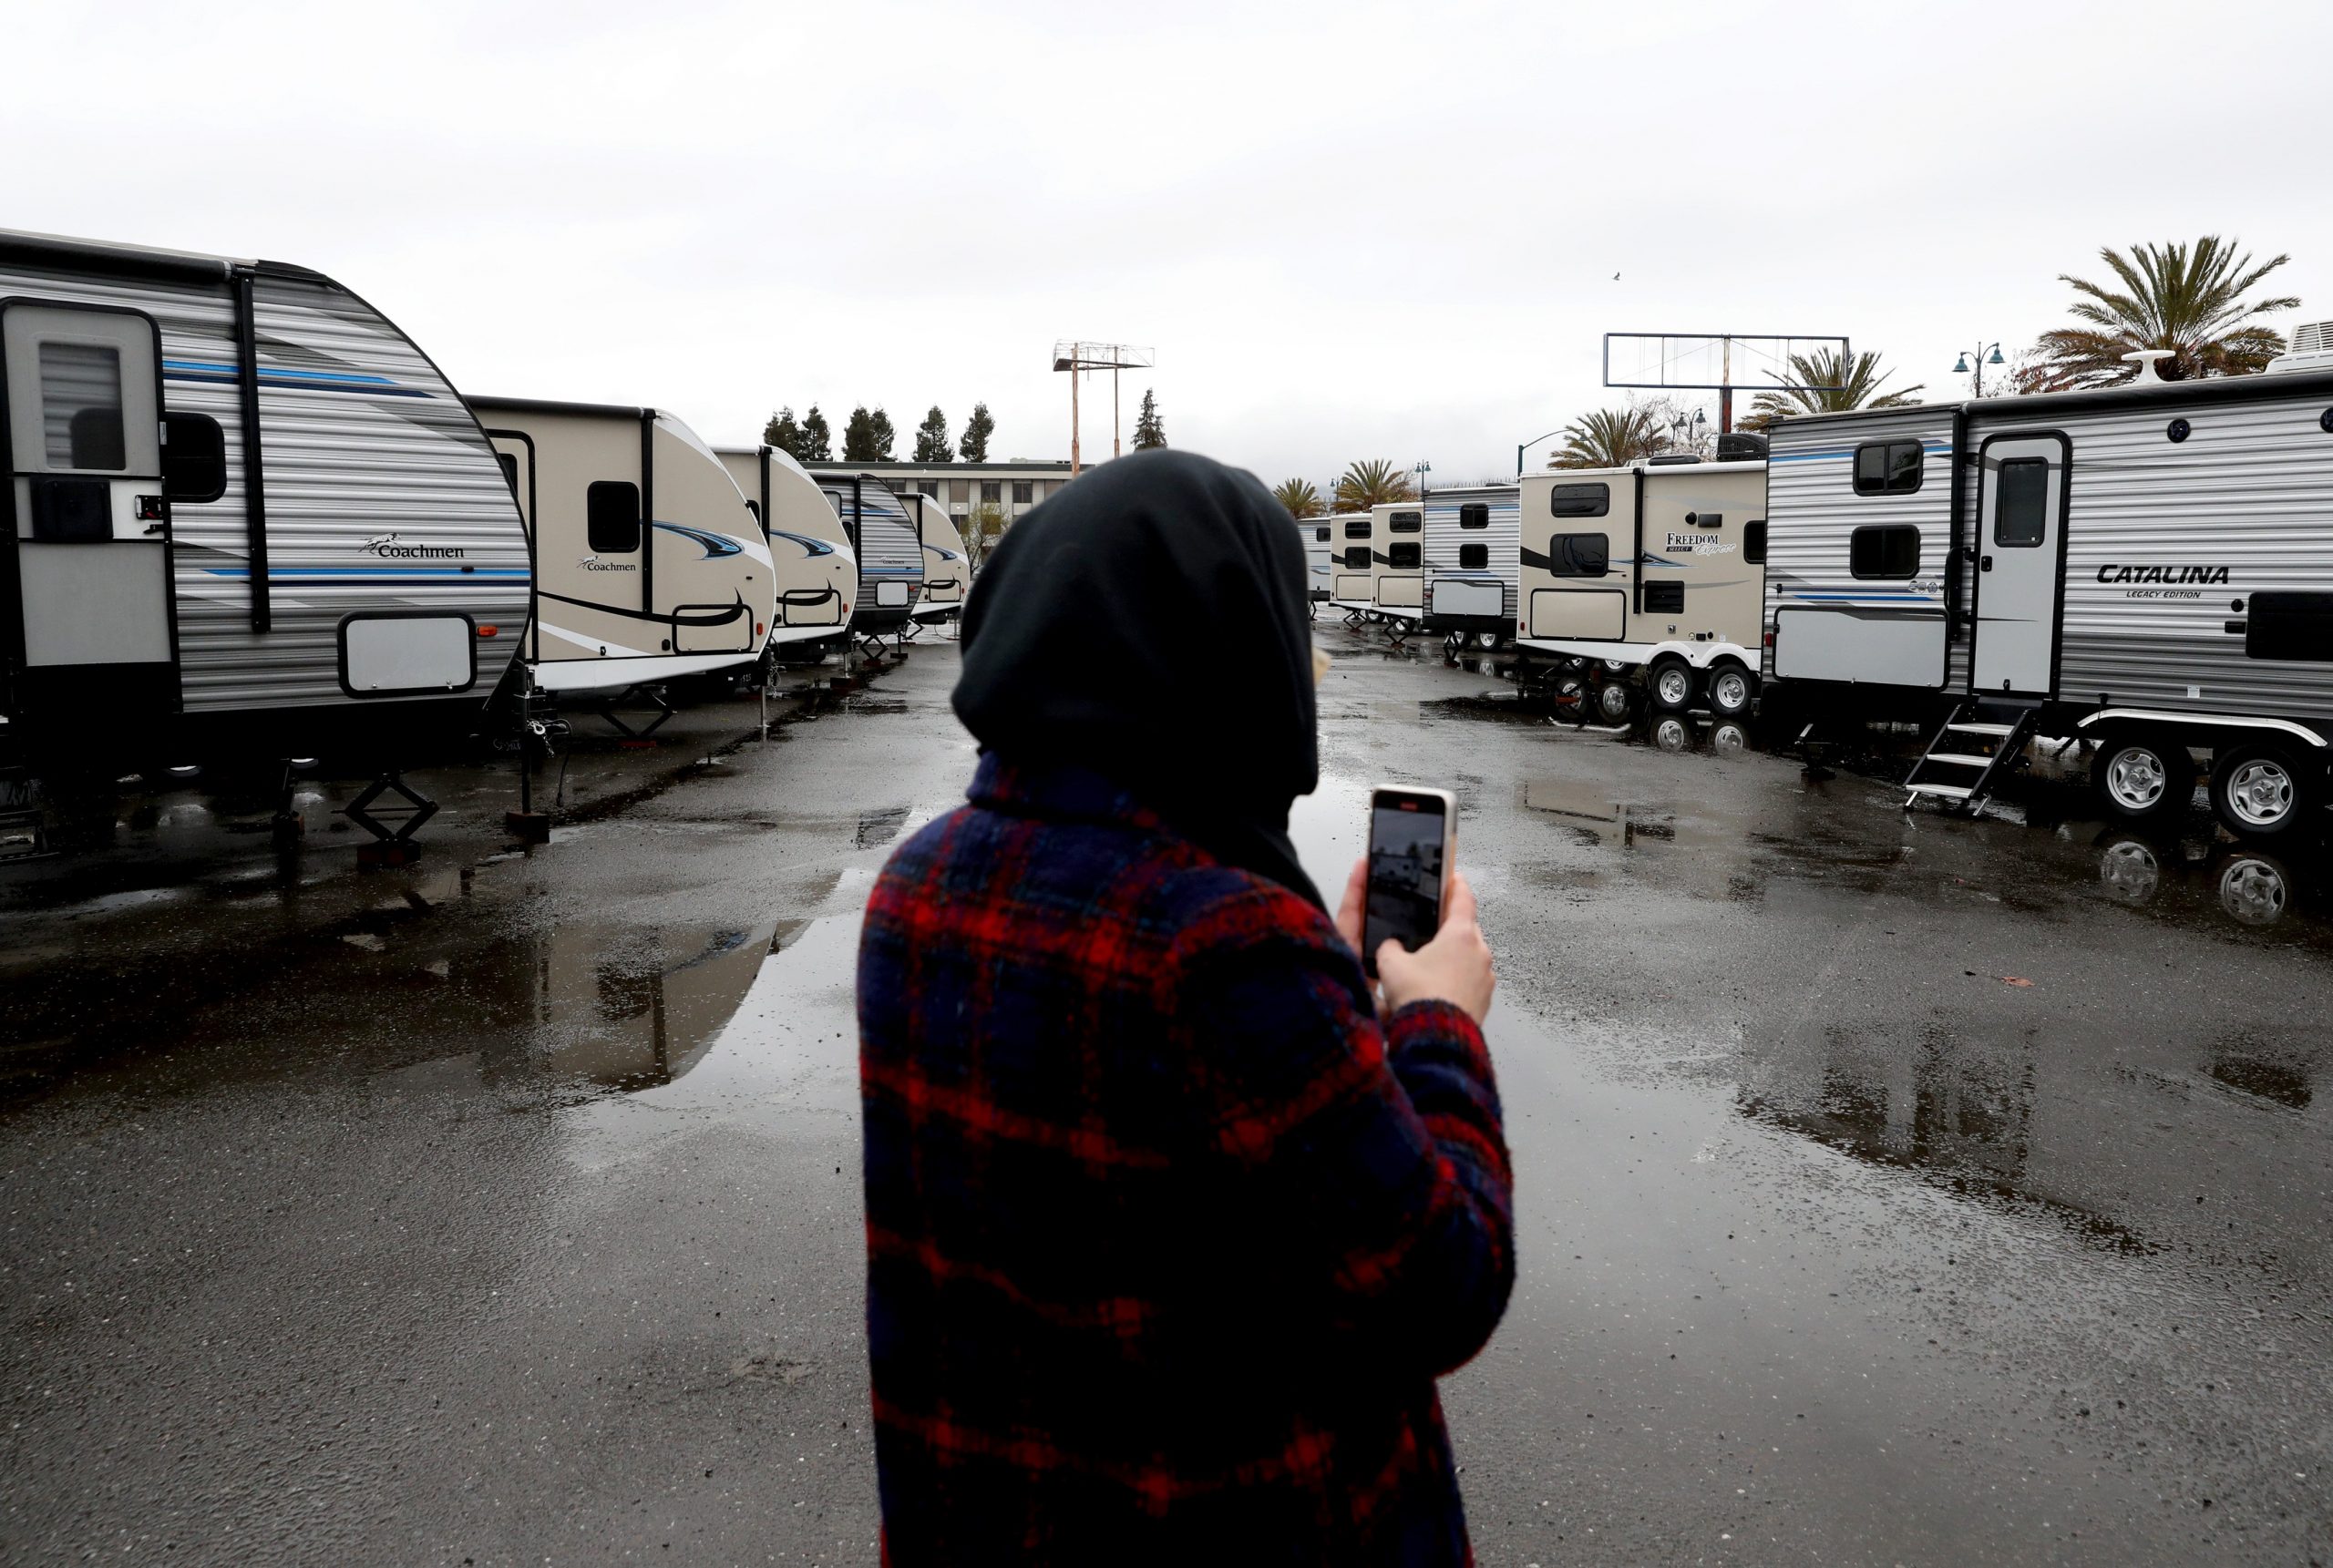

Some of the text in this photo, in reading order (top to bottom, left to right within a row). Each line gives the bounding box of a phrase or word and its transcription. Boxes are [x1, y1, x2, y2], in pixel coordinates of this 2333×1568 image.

[1667, 532, 1719, 545] FREEDOM
[378, 544, 464, 558] Coachmen
[1695, 544, 1735, 556] Express
[587, 562, 636, 571] Coachmen
[2097, 564, 2229, 584] CATALINA
